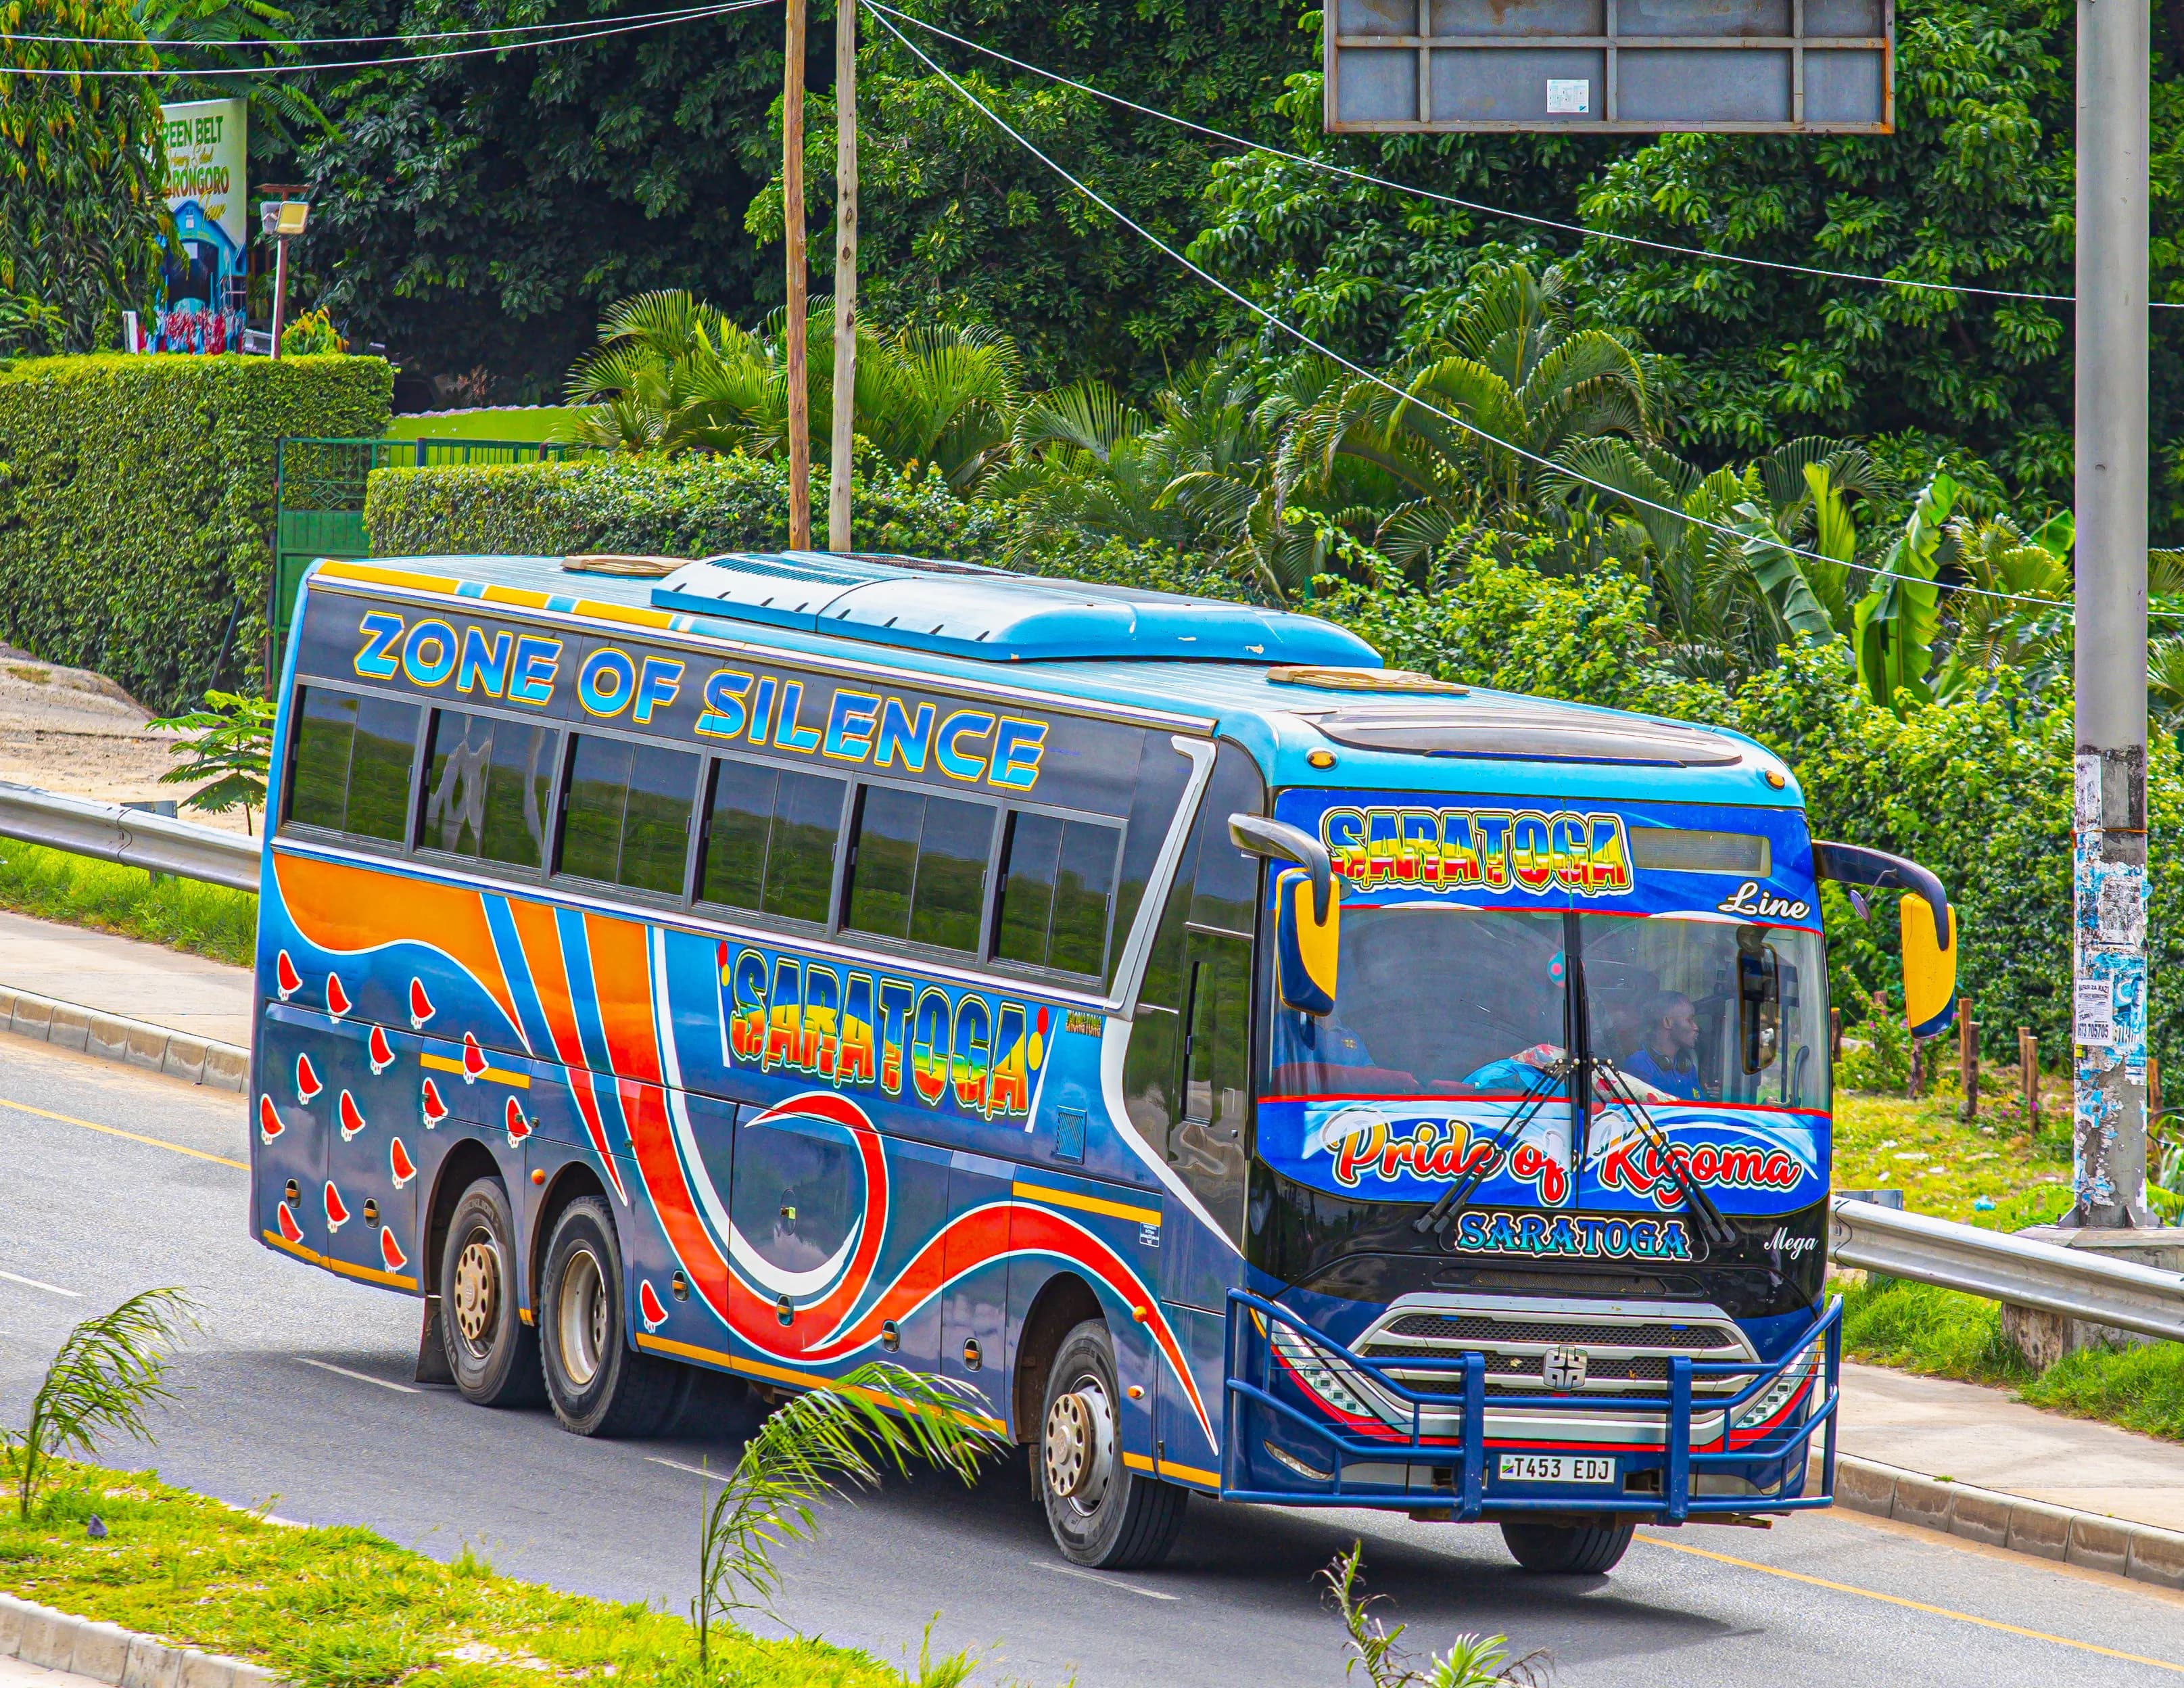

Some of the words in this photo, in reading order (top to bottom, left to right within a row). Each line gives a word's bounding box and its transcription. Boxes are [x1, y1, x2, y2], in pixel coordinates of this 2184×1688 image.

[162, 119, 192, 147] REEN
[195, 116, 223, 145] BELT
[162, 166, 229, 197] RONGORO
[354, 609, 563, 705] ZONE
[578, 647, 686, 724] OF
[694, 668, 1049, 791] SILENCE
[1321, 807, 1634, 897] SARATOGA
[1717, 881, 1811, 920] Line
[730, 947, 1029, 1121] SARATOGA
[1321, 1108, 1506, 1188] Pride
[1510, 1130, 1572, 1208] of
[1590, 1111, 1804, 1211] Kigoma
[1456, 1211, 1690, 1261] SARATOGA
[1763, 1227, 1822, 1260] Mega
[1515, 1457, 1562, 1478] T453
[1573, 1459, 1609, 1480] EDJ
